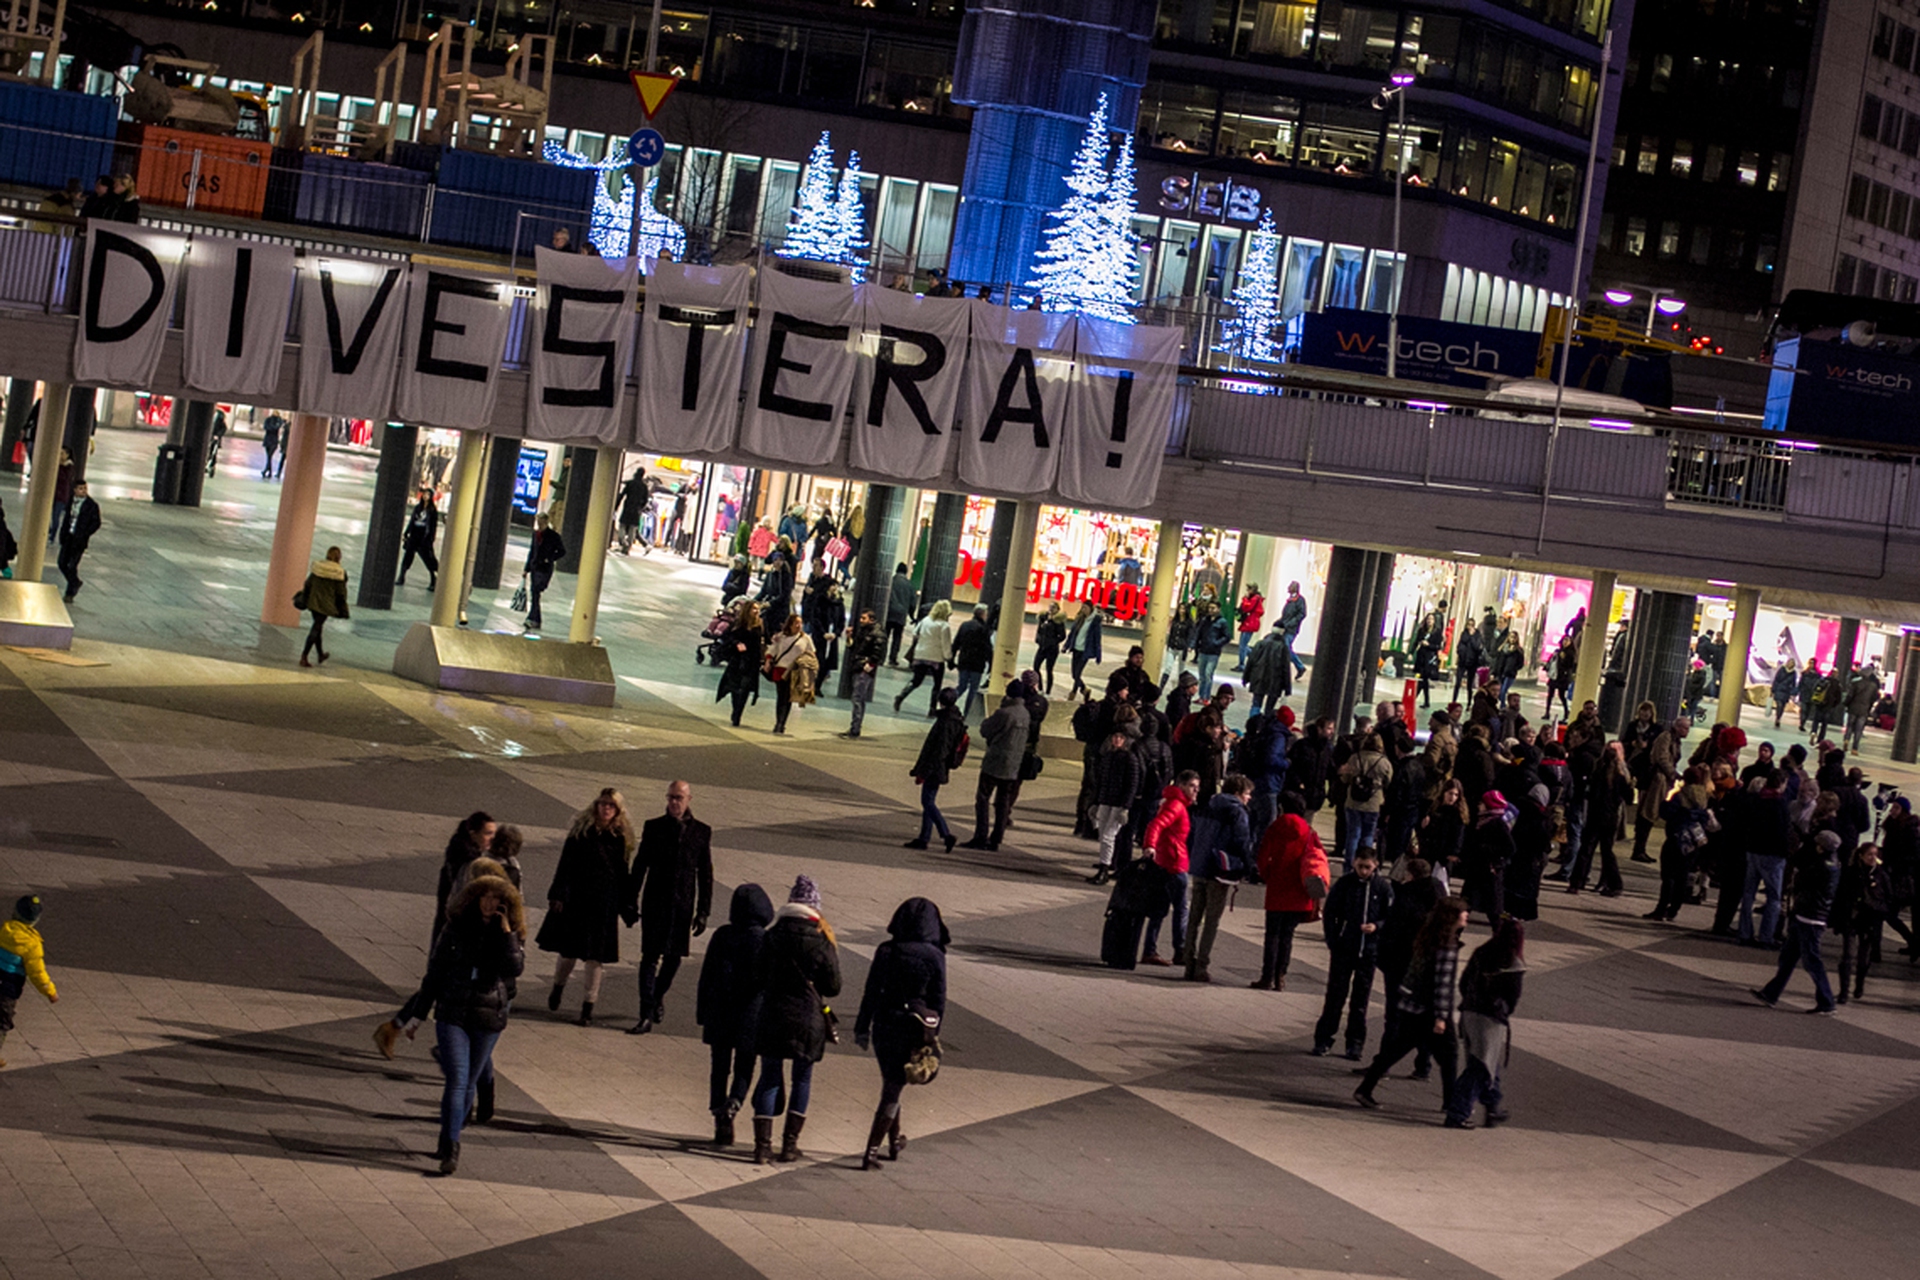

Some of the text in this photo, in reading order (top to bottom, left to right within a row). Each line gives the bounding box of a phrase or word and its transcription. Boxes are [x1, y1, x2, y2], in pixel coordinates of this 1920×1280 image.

[1, 9, 68, 42] VOVO
[1159, 176, 1261, 221] SEB
[86, 229, 1135, 469] DIVESTERA!
